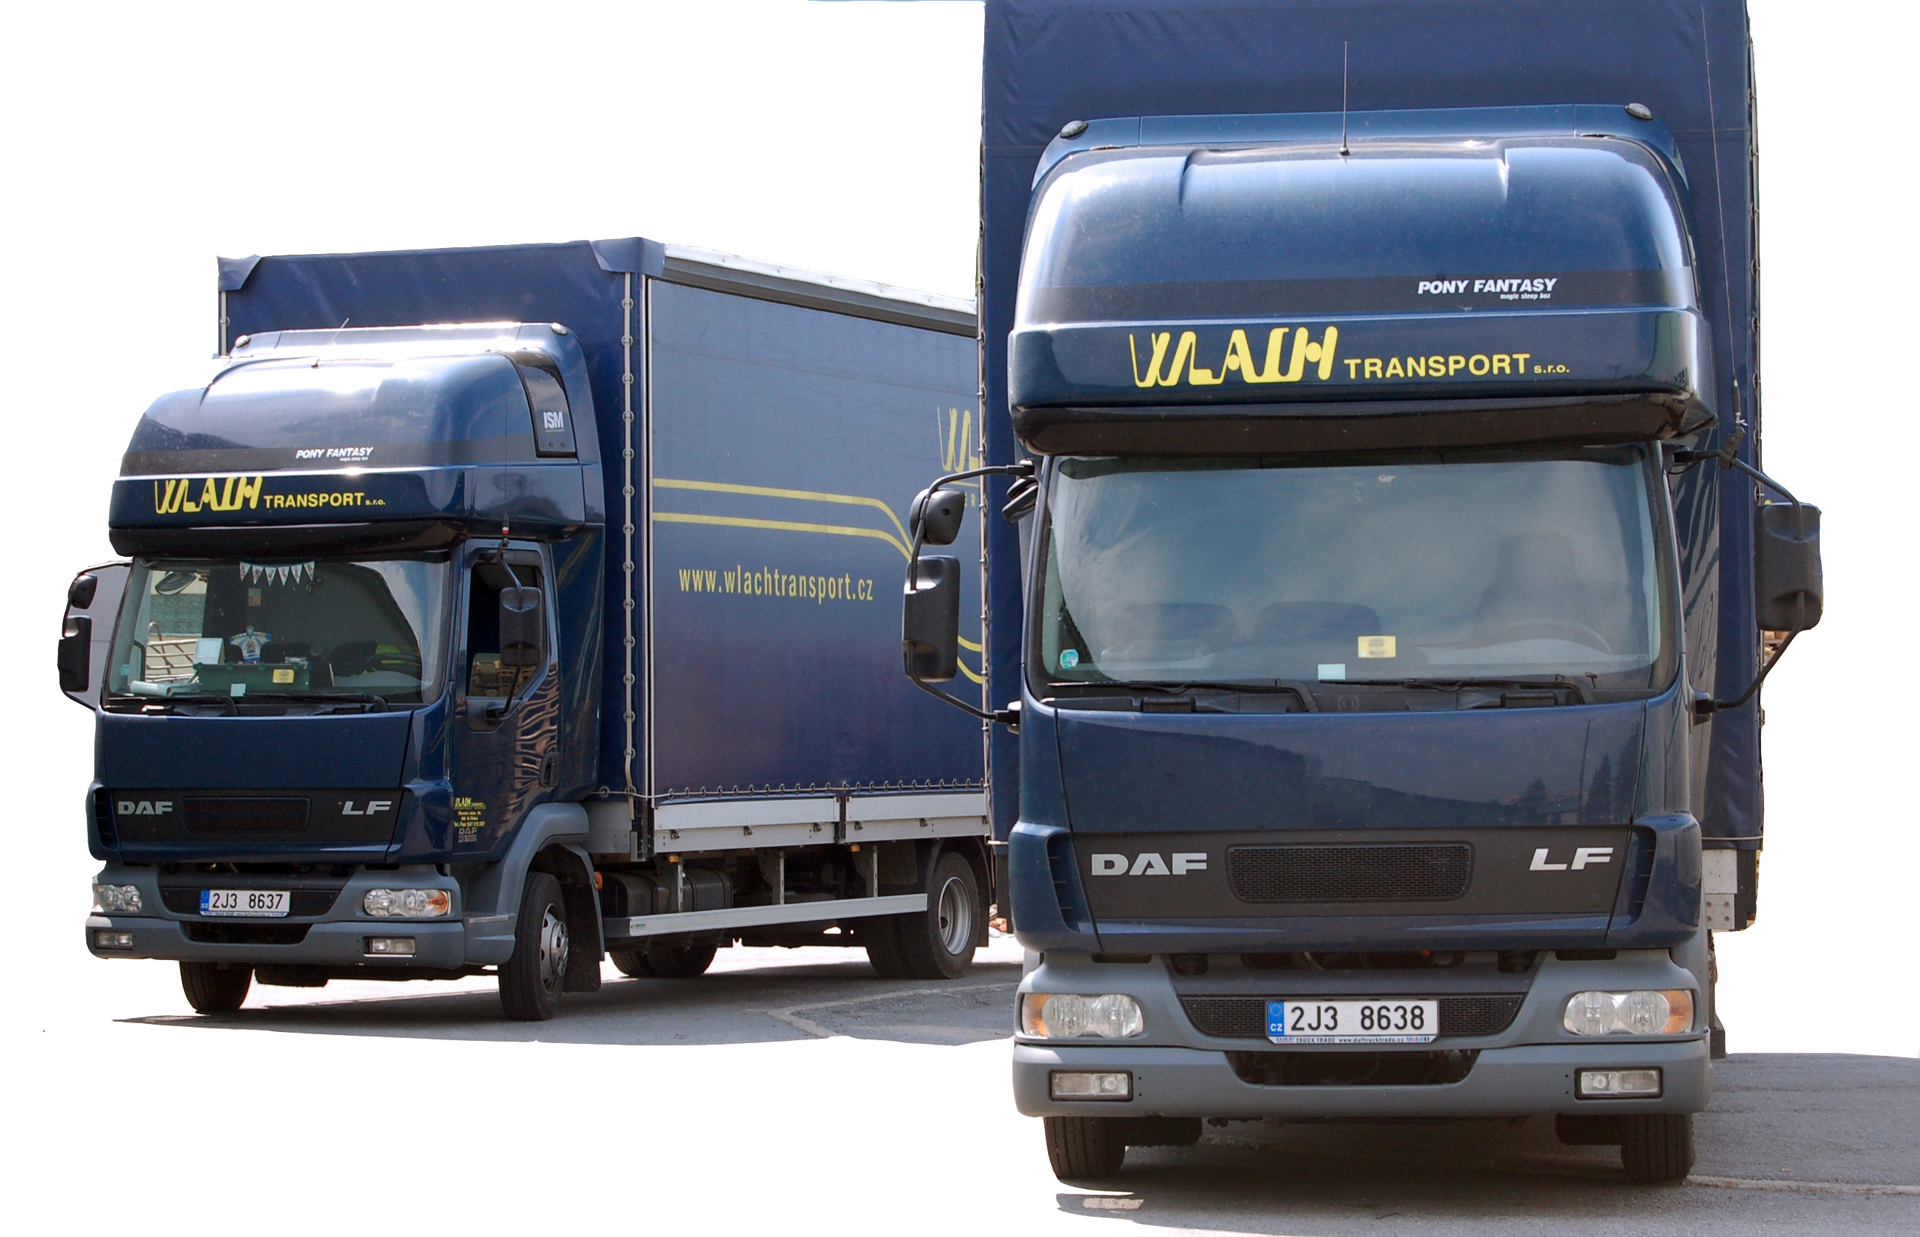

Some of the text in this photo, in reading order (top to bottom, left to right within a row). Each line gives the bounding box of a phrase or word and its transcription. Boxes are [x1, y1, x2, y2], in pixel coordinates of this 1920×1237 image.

[1417, 278, 1558, 294] PONY FANTASY
[1520, 292, 1538, 300] sleep
[1128, 325, 1570, 388] WLACH TRANSPORT s.r.o.
[543, 411, 564, 429] ISM
[295, 447, 374, 459] PONY FANTASY
[155, 476, 263, 514] WLACH
[263, 492, 365, 508] TRANSPORT
[679, 564, 874, 605] www.wlachtransport.cz
[118, 801, 173, 815] DAF
[342, 801, 392, 815] LF
[1091, 853, 1208, 875] DAF
[1530, 847, 1614, 870] LF
[212, 893, 283, 909] 2J3 8637
[1290, 1005, 1425, 1031] 2J3 8638
[1270, 1023, 1283, 1032] CZ
